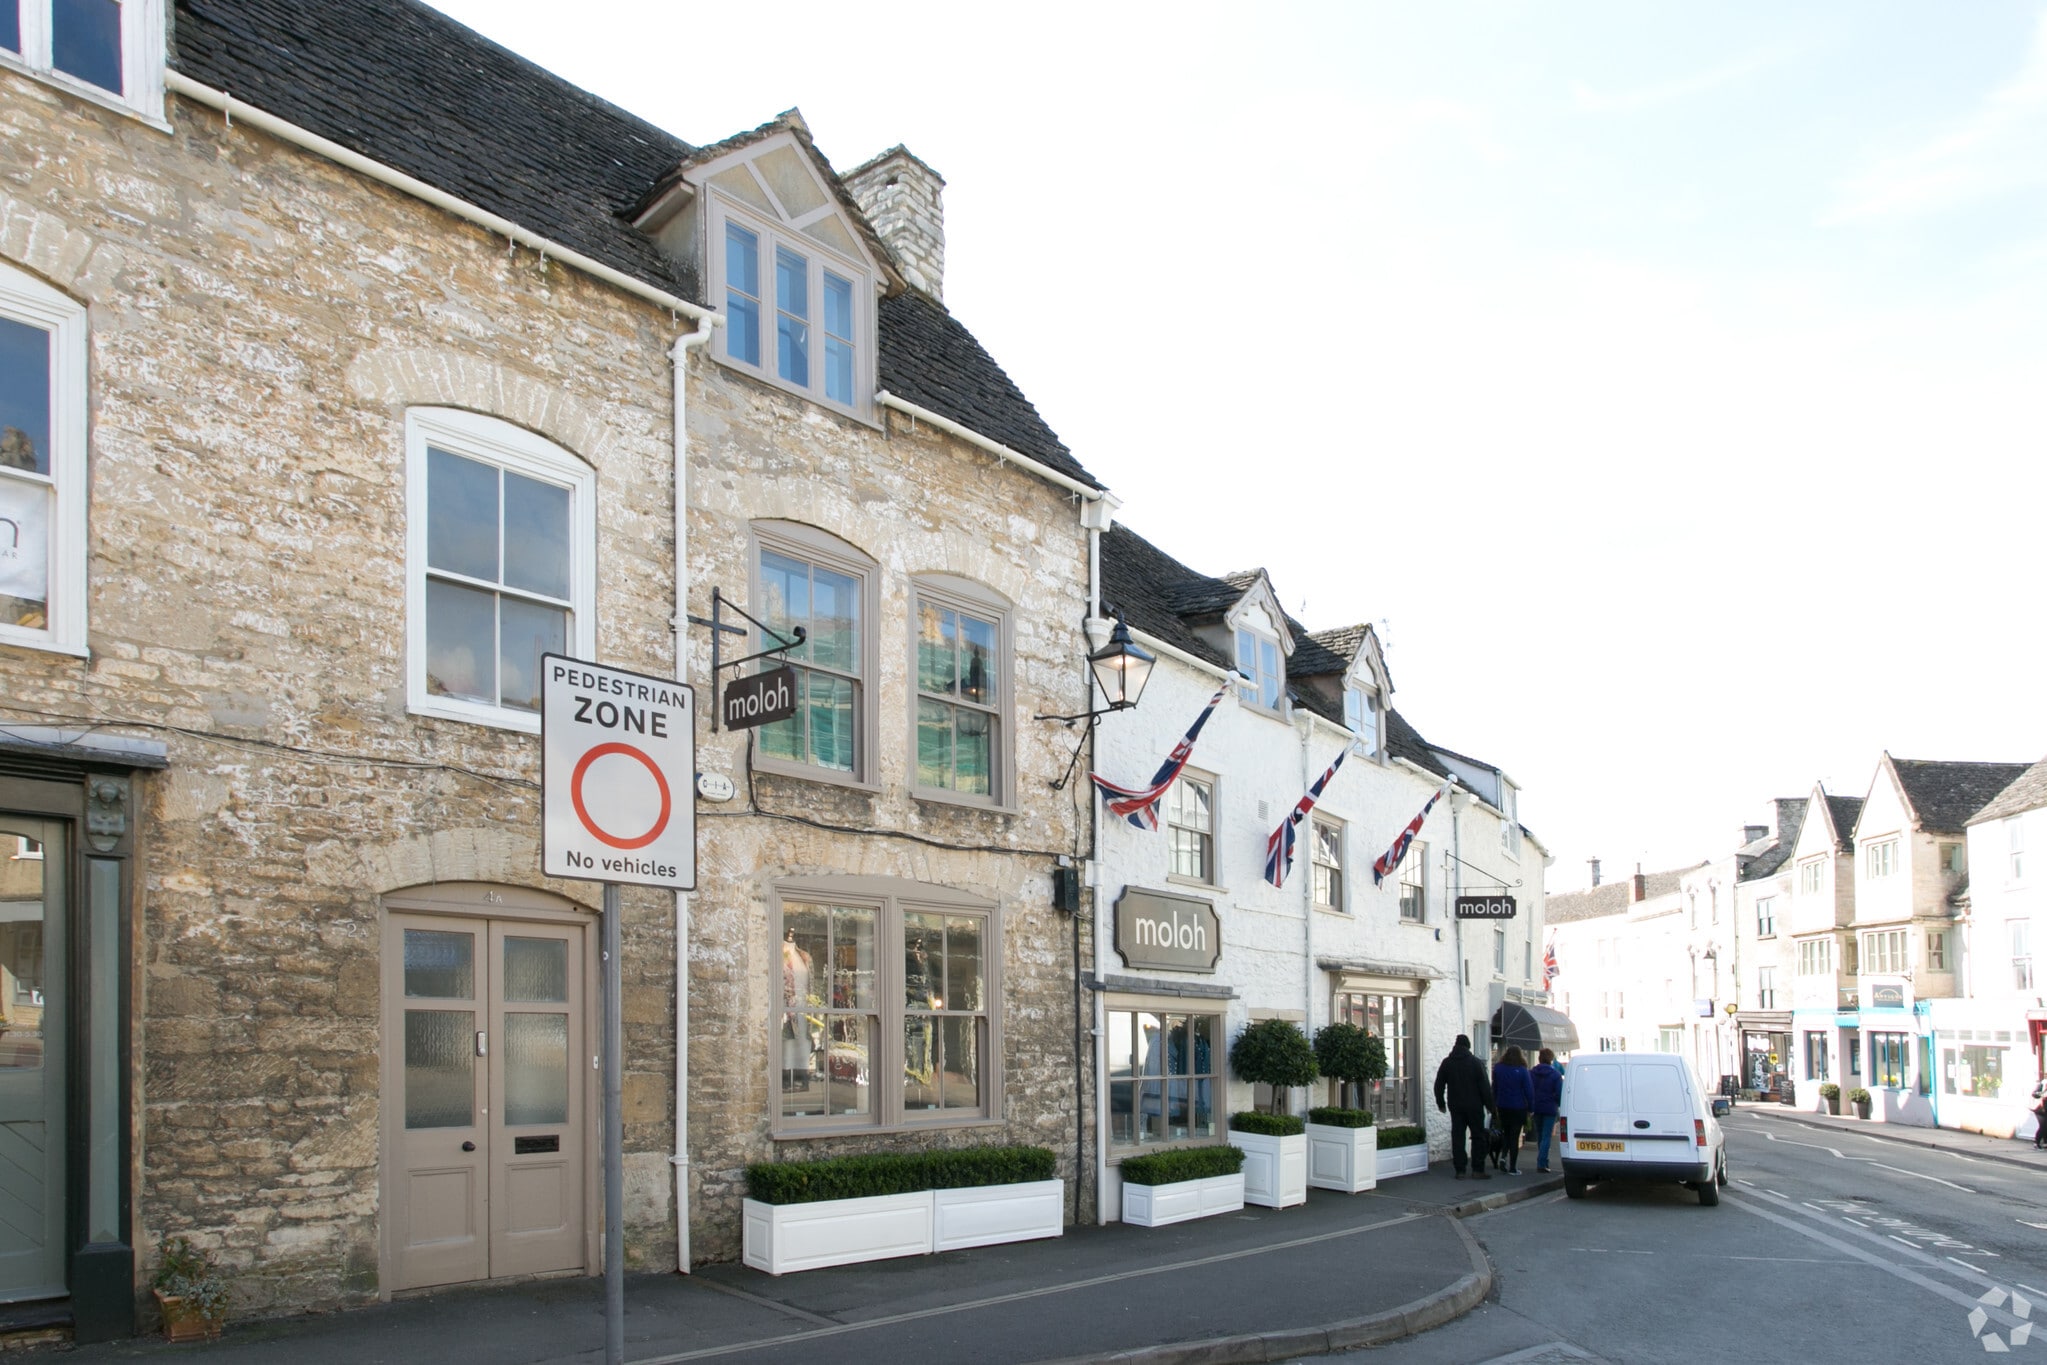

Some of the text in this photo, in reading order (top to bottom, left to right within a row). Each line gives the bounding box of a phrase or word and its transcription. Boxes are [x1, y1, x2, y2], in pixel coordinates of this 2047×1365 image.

[554, 666, 685, 709] PEDESTRIAN
[729, 677, 789, 720] moloh
[574, 696, 668, 738] ZONE
[566, 850, 677, 878] No vehicles
[1460, 899, 1511, 914] moloh
[1135, 910, 1206, 951] moloh
